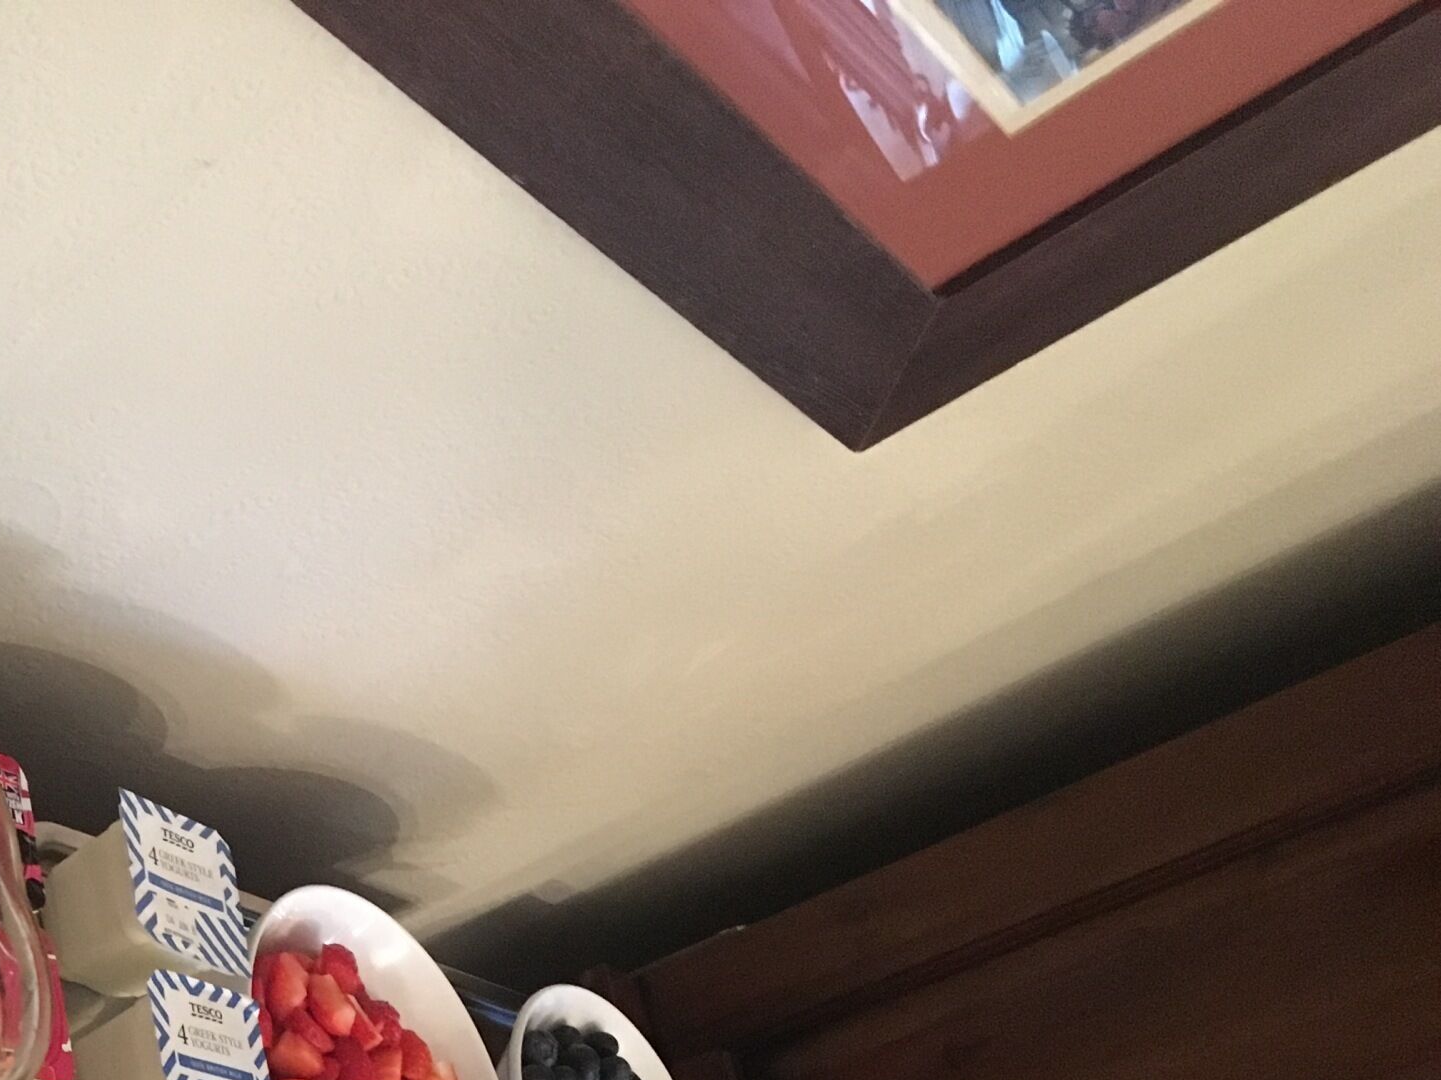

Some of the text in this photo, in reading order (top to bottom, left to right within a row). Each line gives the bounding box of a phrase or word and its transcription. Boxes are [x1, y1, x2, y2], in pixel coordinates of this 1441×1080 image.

[161, 827, 195, 850] TESCO
[148, 846, 159, 866] 4
[189, 1001, 223, 1020] TESCO
[177, 1024, 243, 1050] 4 GREEK STYLE
[191, 1036, 231, 1056] YOGURTS
